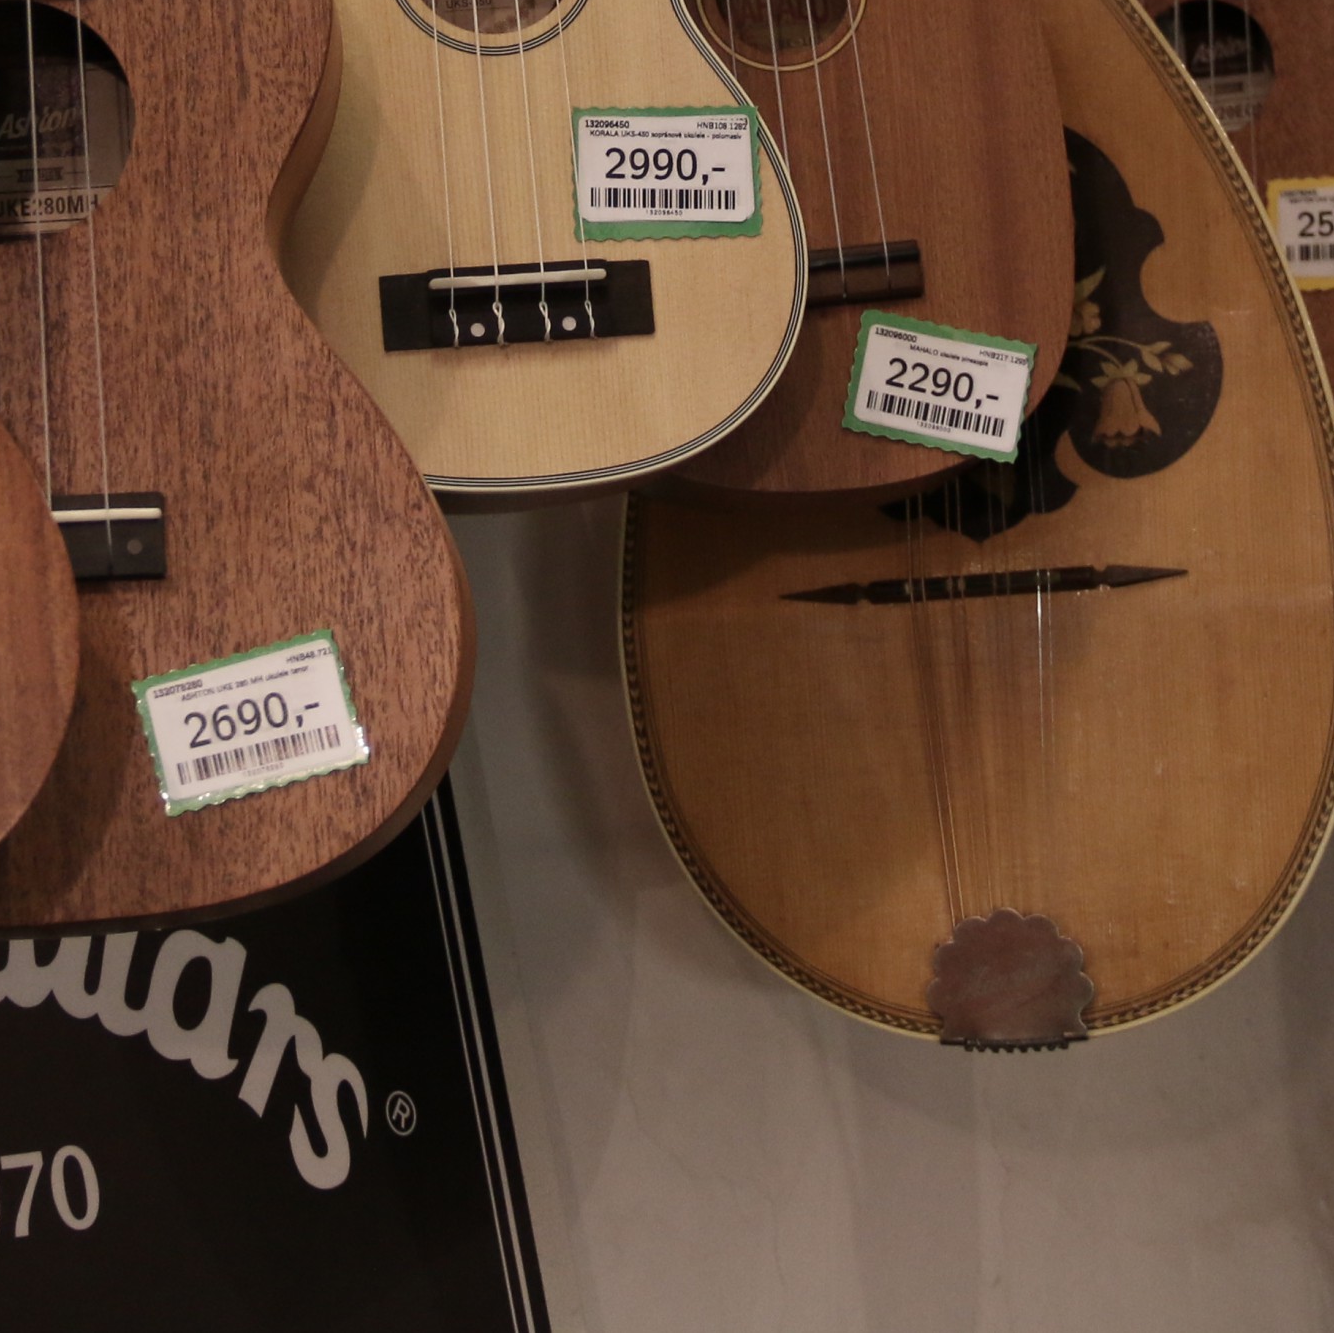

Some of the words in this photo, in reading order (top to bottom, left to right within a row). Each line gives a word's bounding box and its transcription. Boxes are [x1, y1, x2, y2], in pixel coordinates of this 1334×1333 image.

[585, 119, 630, 129] 132096450
[605, 147, 726, 186] 2990,-
[885, 357, 999, 409] 2290,-
[183, 692, 320, 749] 2690,-
